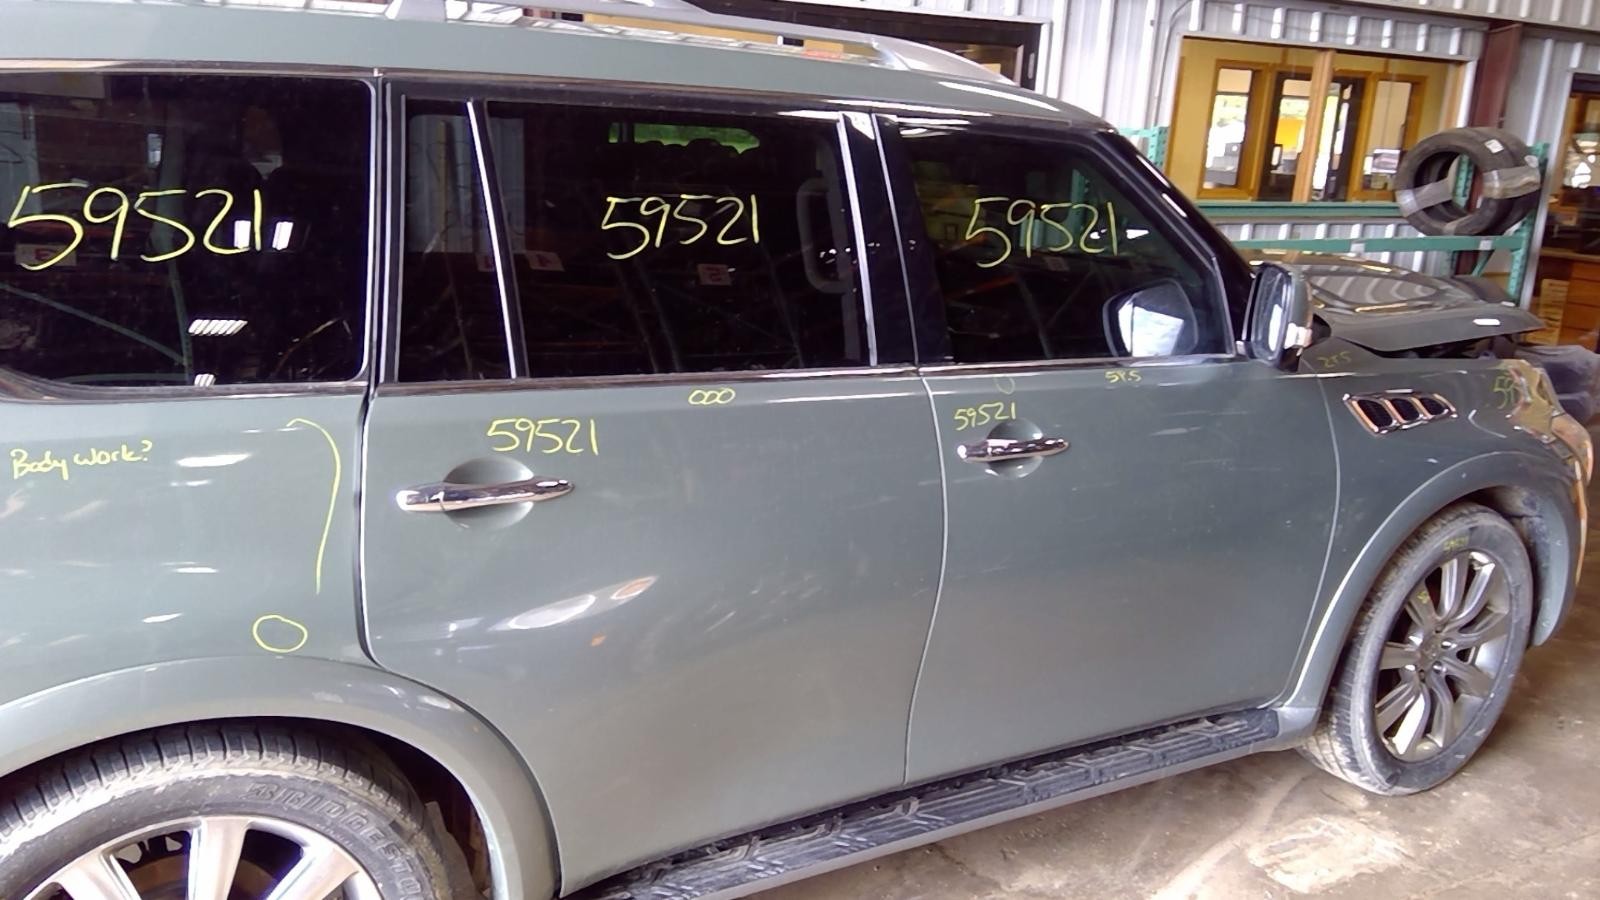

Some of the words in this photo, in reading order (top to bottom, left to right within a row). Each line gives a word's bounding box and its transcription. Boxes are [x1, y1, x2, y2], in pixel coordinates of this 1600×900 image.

[8, 182, 263, 271] 59521
[600, 194, 760, 260] 59521
[965, 197, 1118, 269] 59521
[486, 418, 599, 456] 59521
[954, 402, 1016, 431] 59521
[10, 449, 69, 480] Body
[239, 782, 424, 900] BRIDGESTO
